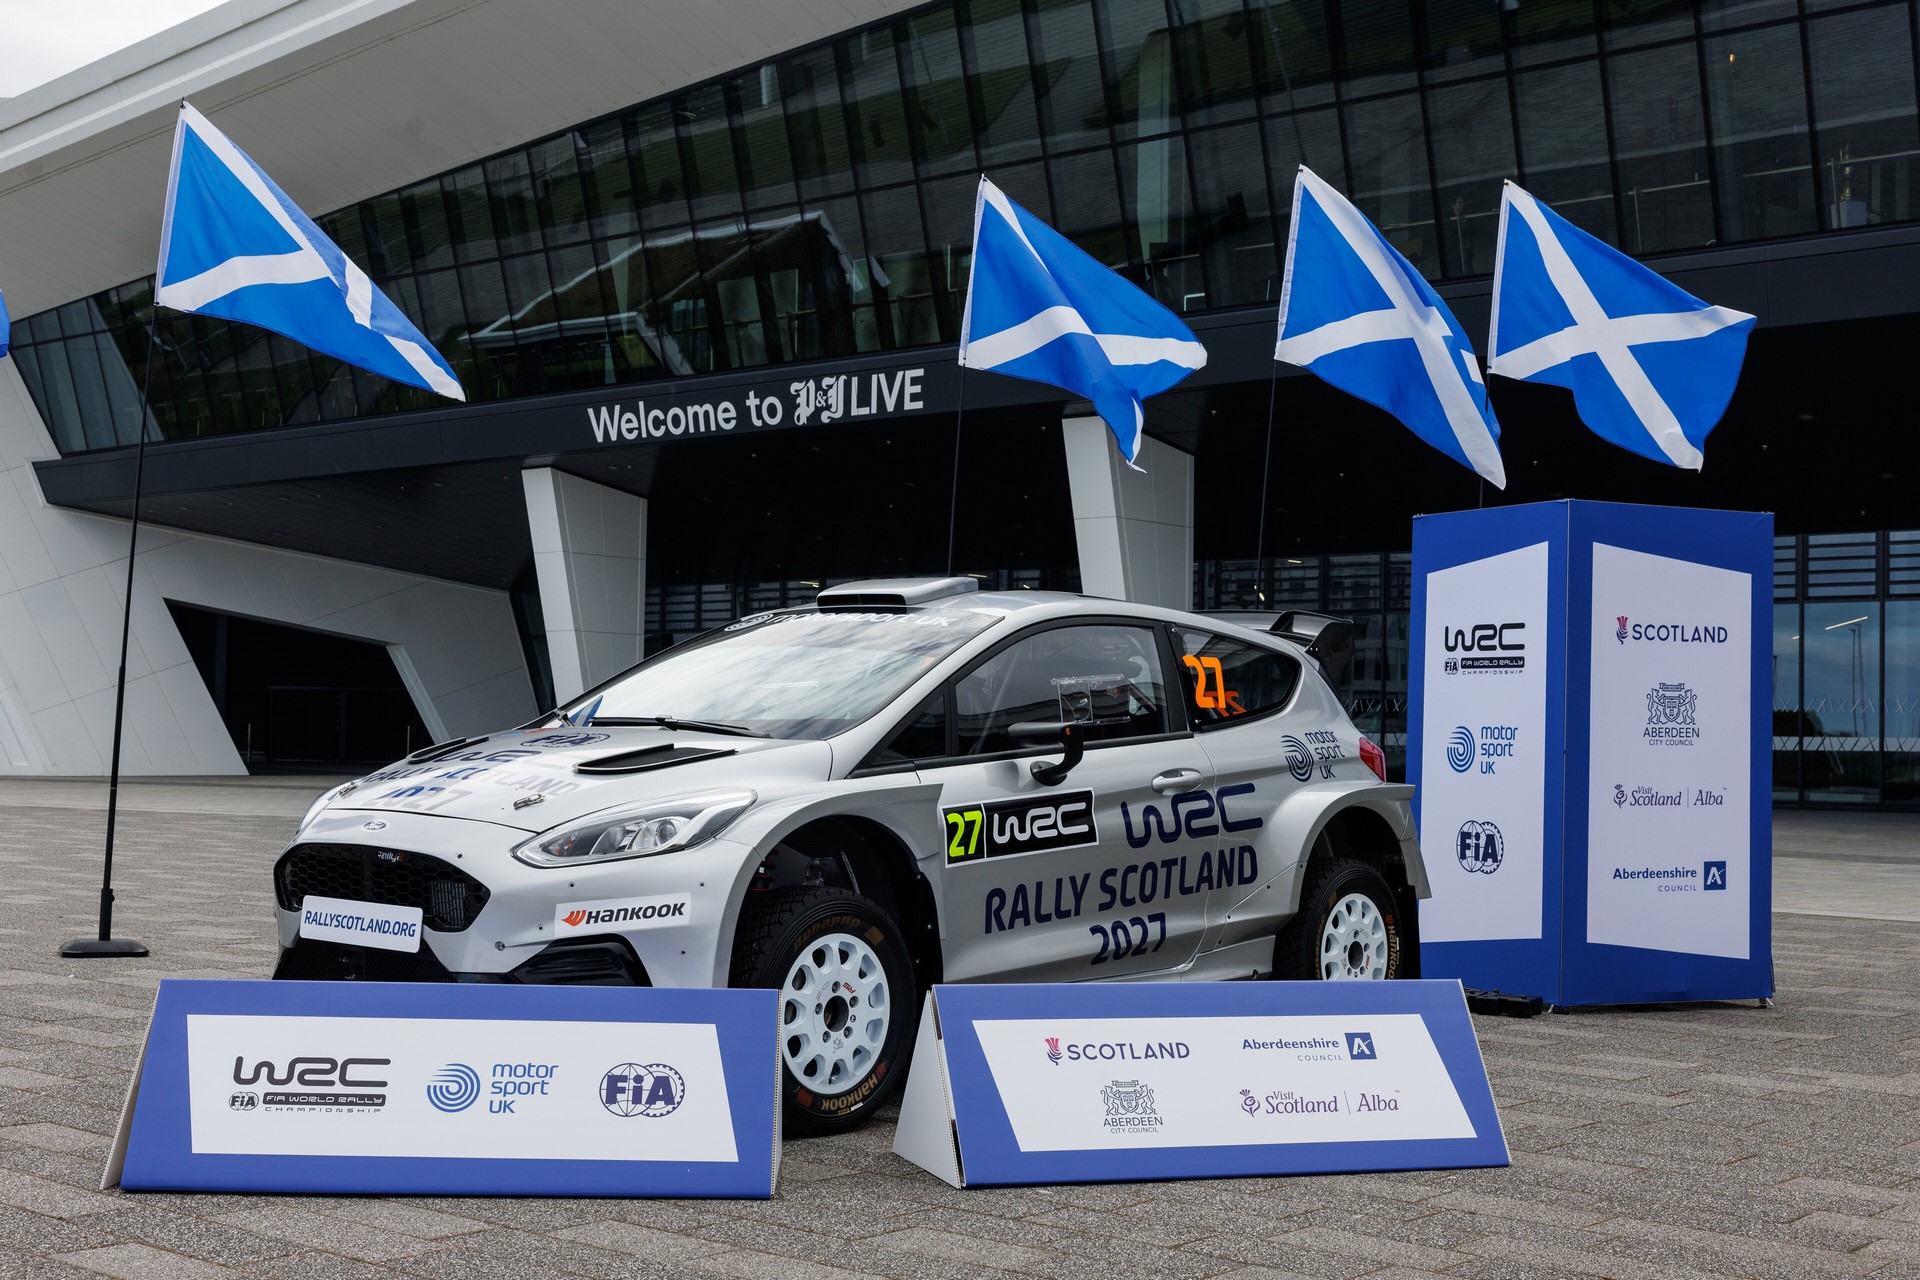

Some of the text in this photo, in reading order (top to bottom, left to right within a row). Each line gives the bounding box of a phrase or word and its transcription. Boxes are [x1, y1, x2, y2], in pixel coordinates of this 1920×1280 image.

[587, 401, 737, 443] Welcome
[745, 390, 783, 427] to
[851, 368, 925, 417] LIVE
[915, 614, 960, 627] UK
[1444, 622, 1525, 652] WRC
[1632, 623, 1728, 643] SCOTLAND
[1182, 654, 1226, 709] 27
[1304, 730, 1338, 745] motor
[1480, 725, 1518, 741] motor
[1643, 727, 1700, 738] ABERDEEN
[1314, 744, 1346, 762] sport
[1480, 741, 1514, 759] sport
[1320, 765, 1336, 779] UK
[1480, 761, 1496, 775] UK
[1629, 789, 1723, 806] Scotland Alba
[1637, 786, 1653, 794] Visit
[1120, 782, 1264, 849] WRC
[946, 802, 1089, 857] 27 WRC
[1613, 867, 1697, 880] Aberdeenshire
[984, 845, 1259, 934] RALLY SCOTLAND
[1658, 884, 1697, 892] COUNCIL
[304, 910, 416, 937] RALLYSCOTLAND.ORG
[1088, 911, 1167, 965] 2027
[1066, 1042, 1190, 1061] SCOTLAND
[1242, 1037, 1340, 1050] Aberdeenshire
[233, 1056, 391, 1087] WRC
[492, 1062, 559, 1078] motor
[491, 1079, 550, 1097] sport
[1273, 1091, 1295, 1099] Visit
[489, 1100, 516, 1114] UK
[1266, 1093, 1399, 1114] Scotland Alba
[1103, 1116, 1163, 1127] ABERDEEN
